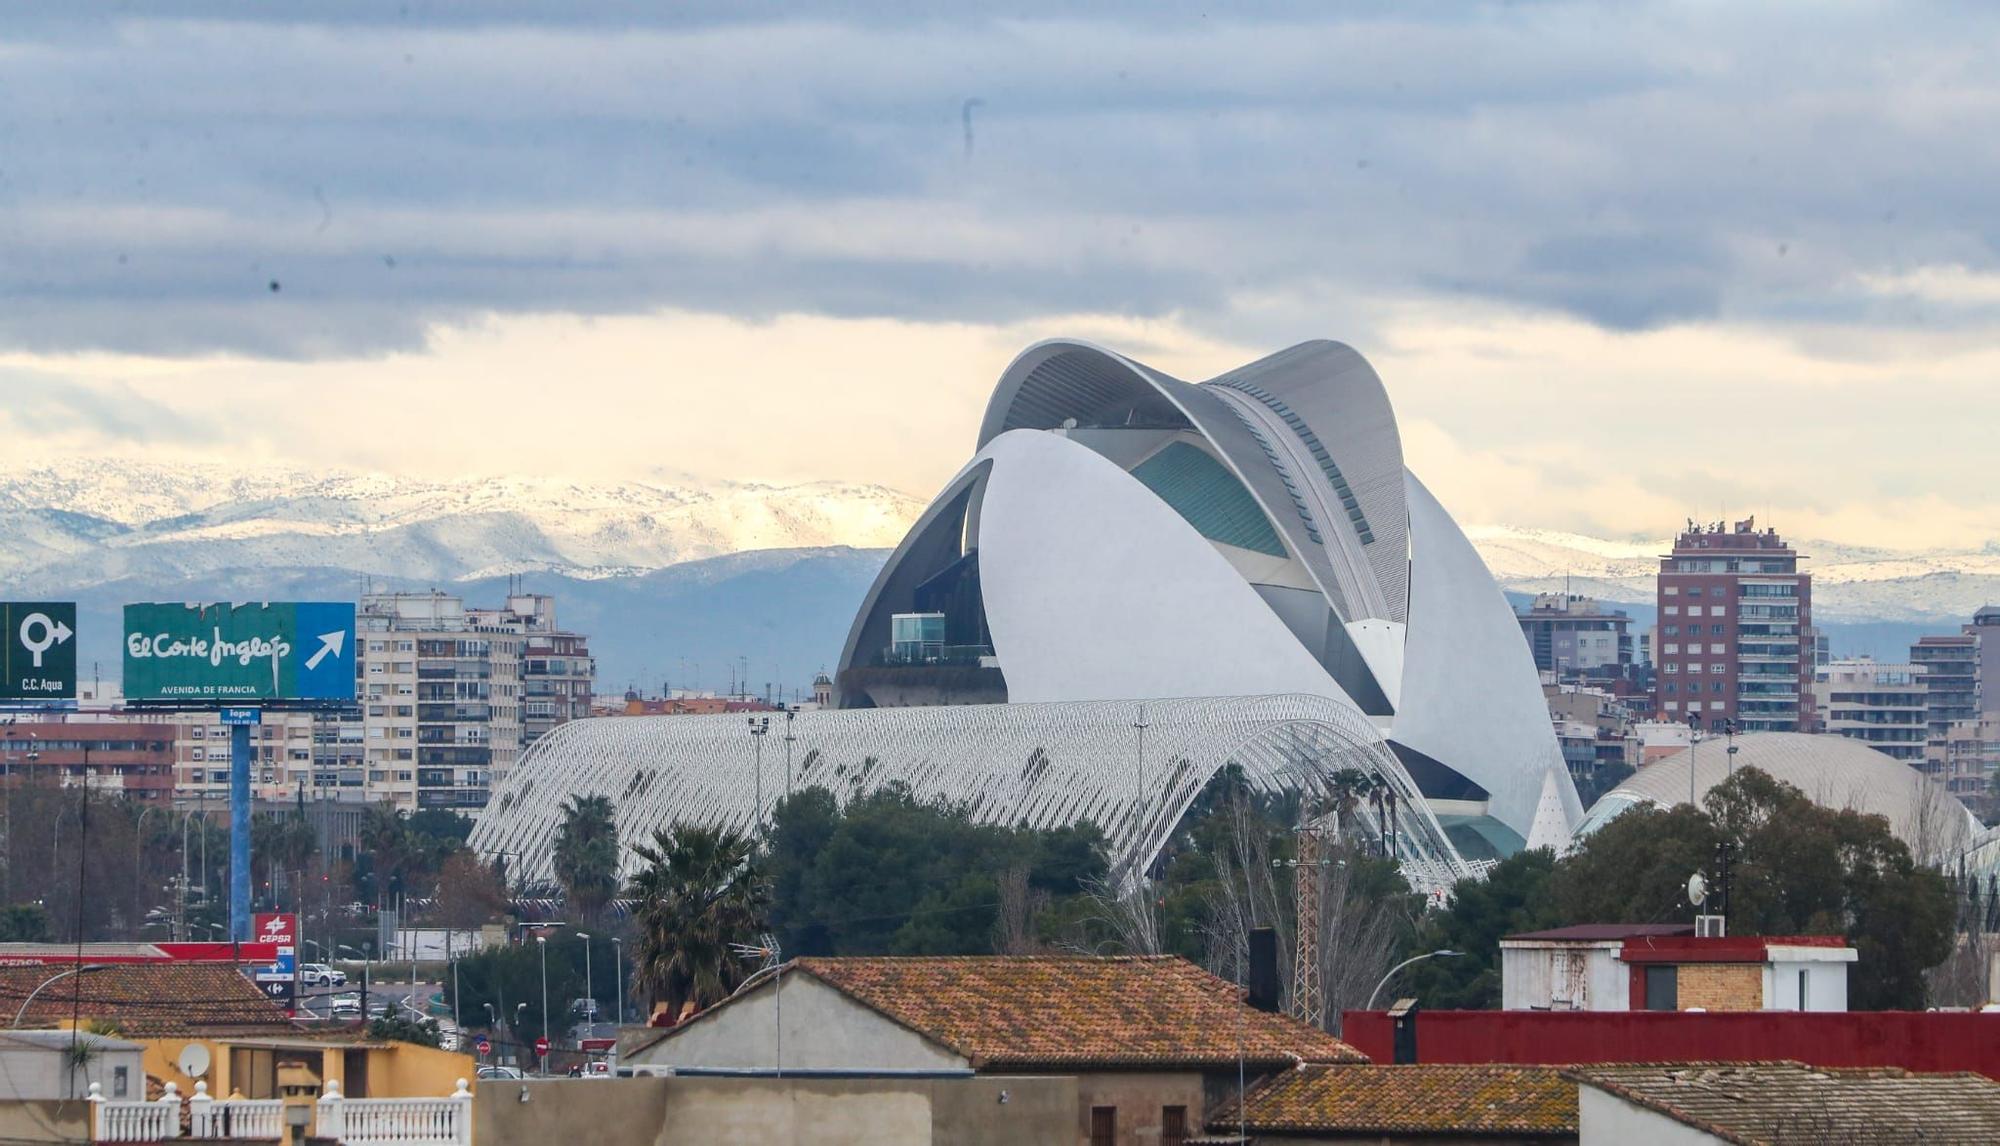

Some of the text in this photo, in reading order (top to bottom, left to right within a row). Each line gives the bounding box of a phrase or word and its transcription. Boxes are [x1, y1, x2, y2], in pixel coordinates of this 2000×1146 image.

[127, 632, 151, 658] El
[152, 633, 208, 658] Corte
[22, 678, 63, 692] C.C. Aqua
[161, 686, 256, 694] AVENIDA DE FRANCIA
[260, 935, 291, 943] CEPSA
